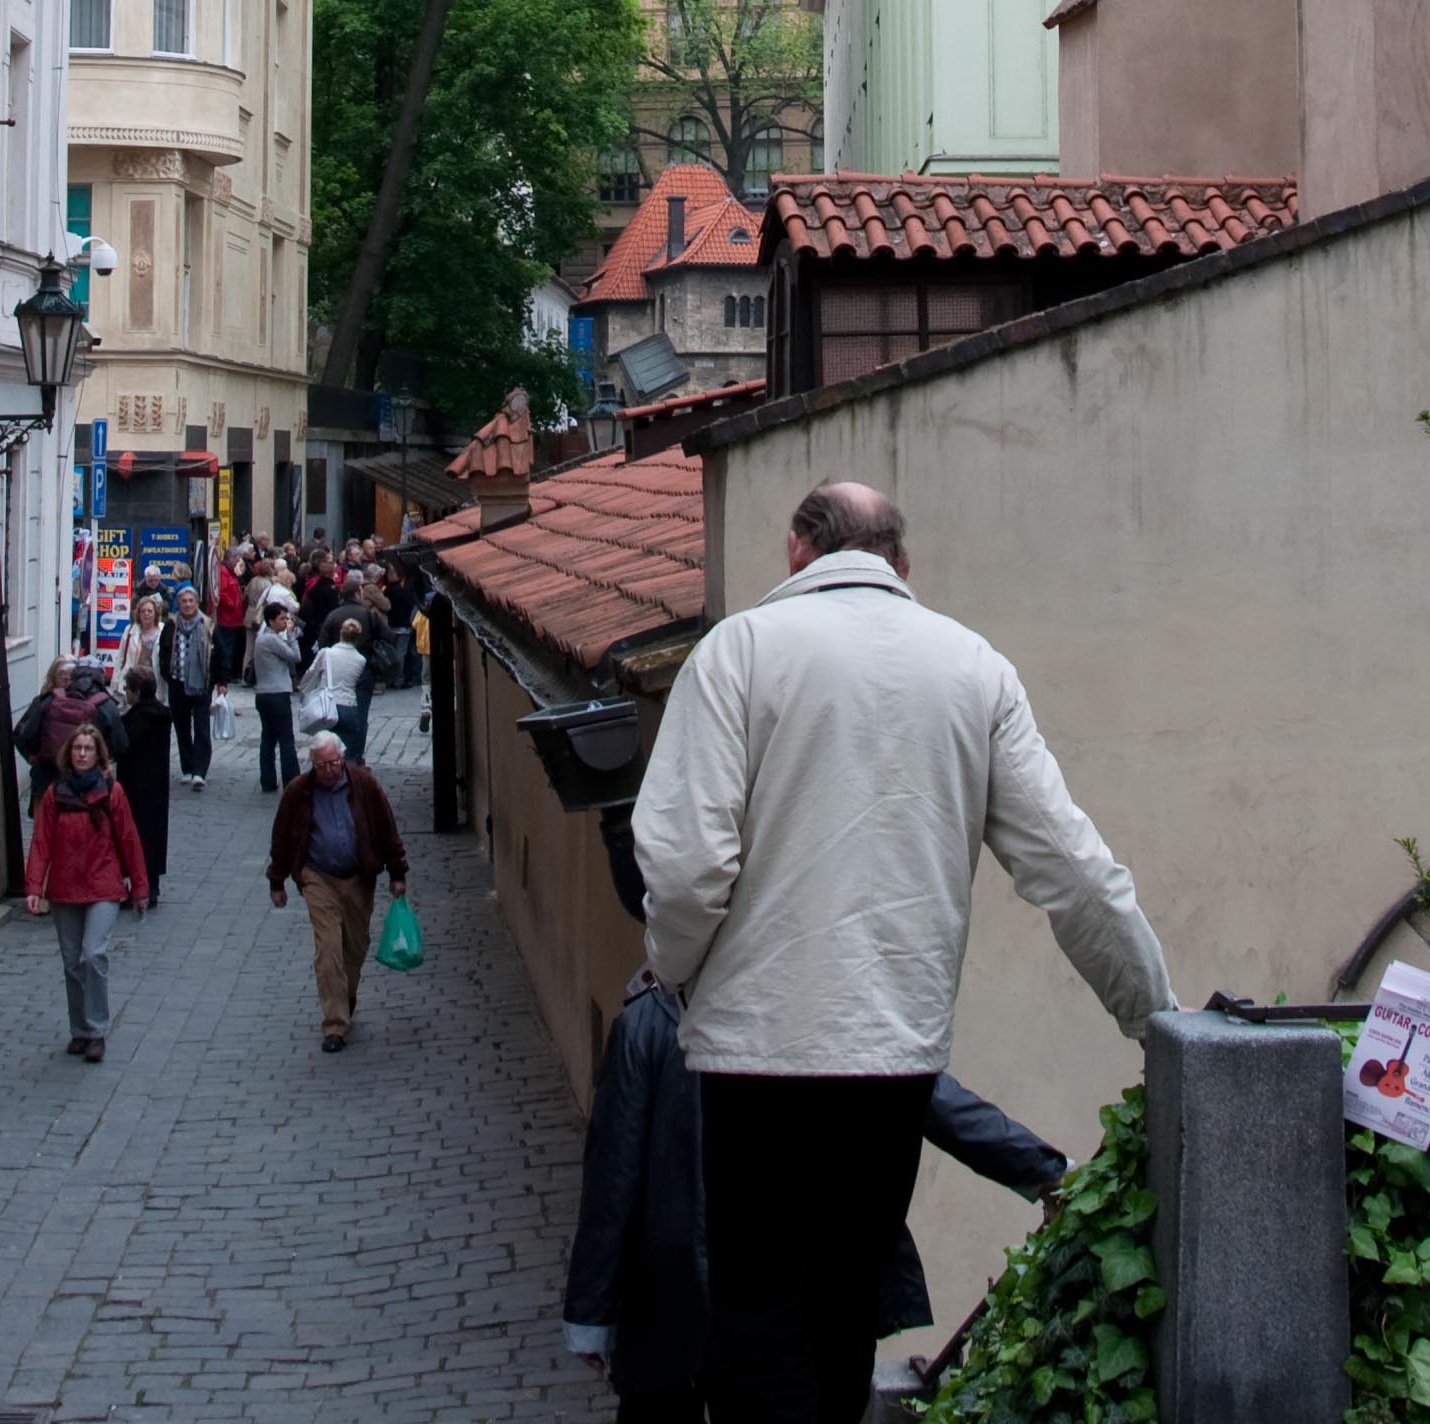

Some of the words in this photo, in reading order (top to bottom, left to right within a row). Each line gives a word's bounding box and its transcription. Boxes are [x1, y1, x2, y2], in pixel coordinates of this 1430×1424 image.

[96, 468, 104, 500] P
[97, 529, 127, 543] GIFT
[1374, 1004, 1411, 1030] GUITAR
